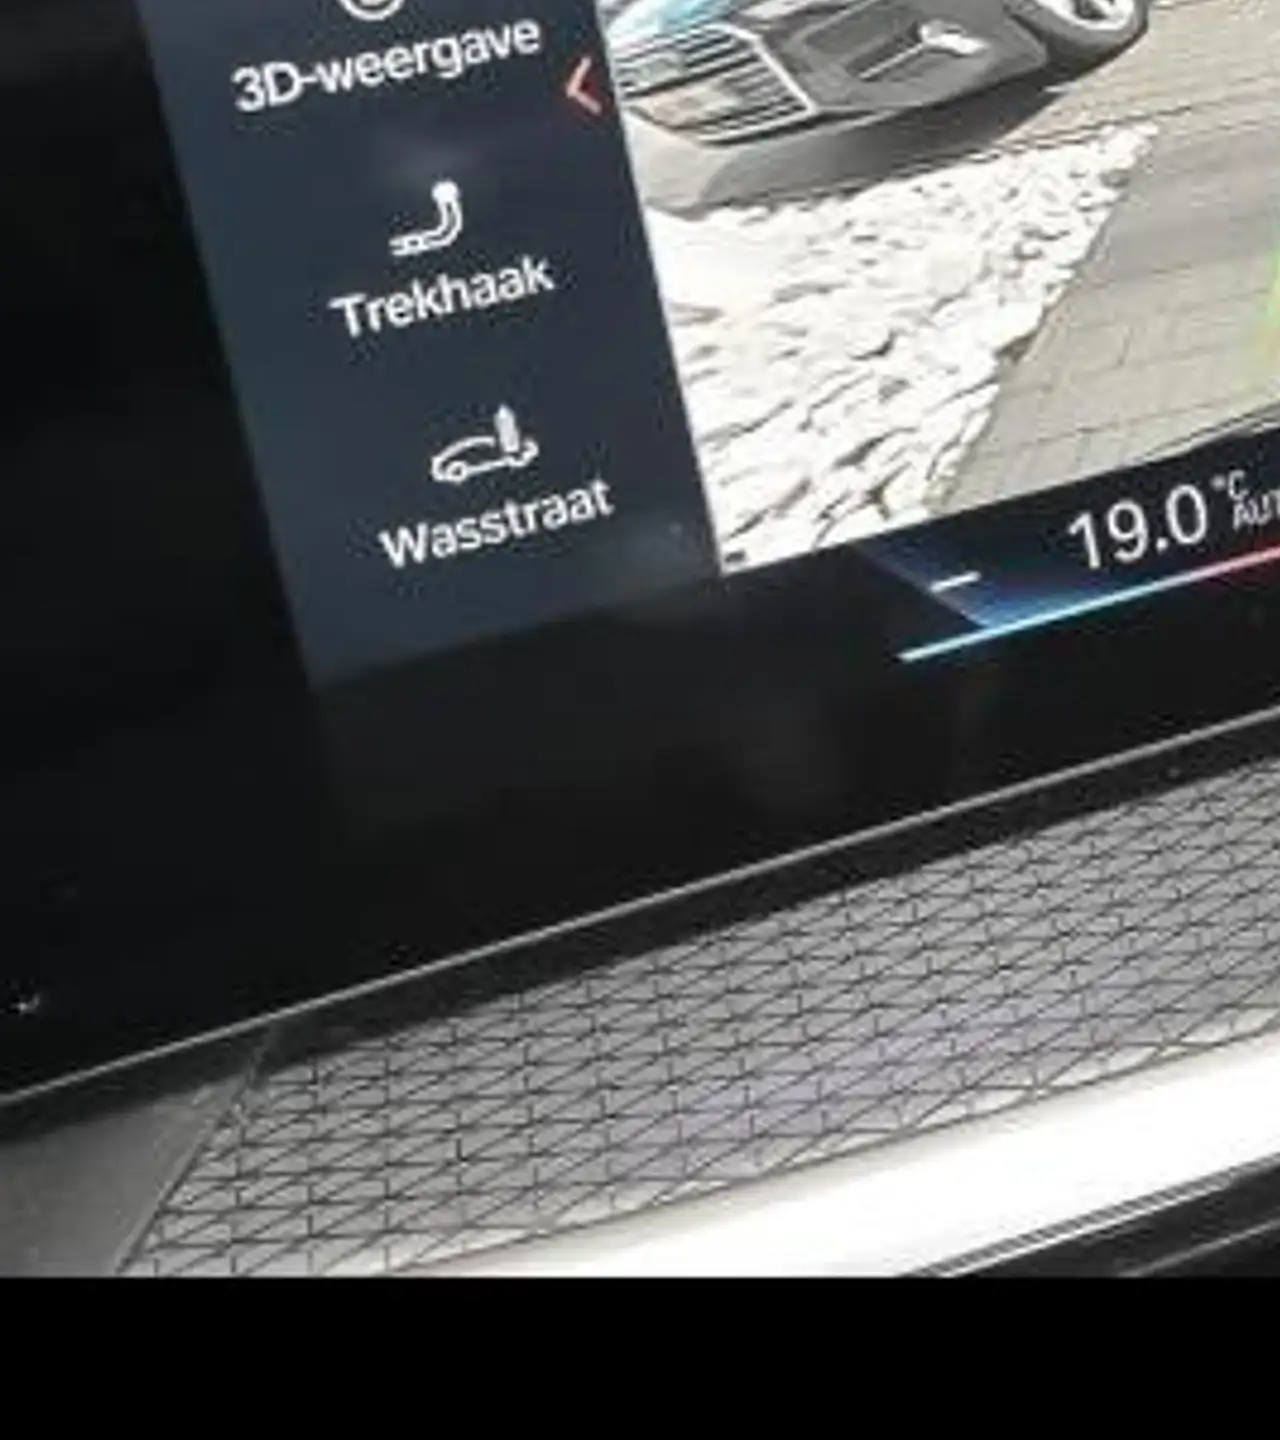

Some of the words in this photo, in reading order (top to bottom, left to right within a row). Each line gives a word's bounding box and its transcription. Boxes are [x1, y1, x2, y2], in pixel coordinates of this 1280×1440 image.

[232, 19, 542, 114] 3D-weergave
[329, 255, 556, 339] Trekhaak
[378, 477, 616, 570] Wasstraat
[1067, 483, 1208, 570] 19.0
